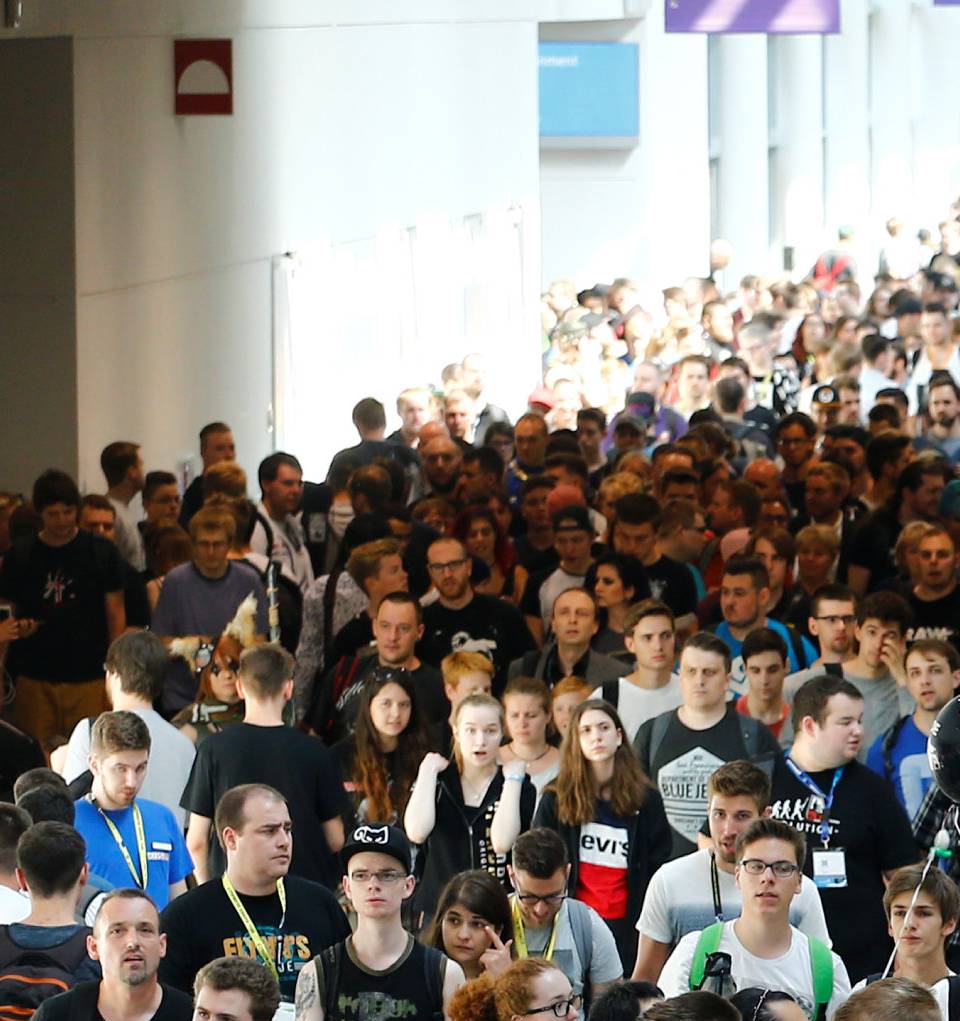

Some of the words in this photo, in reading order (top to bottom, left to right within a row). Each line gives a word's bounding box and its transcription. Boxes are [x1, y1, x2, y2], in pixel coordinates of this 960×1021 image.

[662, 783, 693, 799] BLUE
[695, 784, 708, 799] JE
[581, 834, 629, 857] evi's
